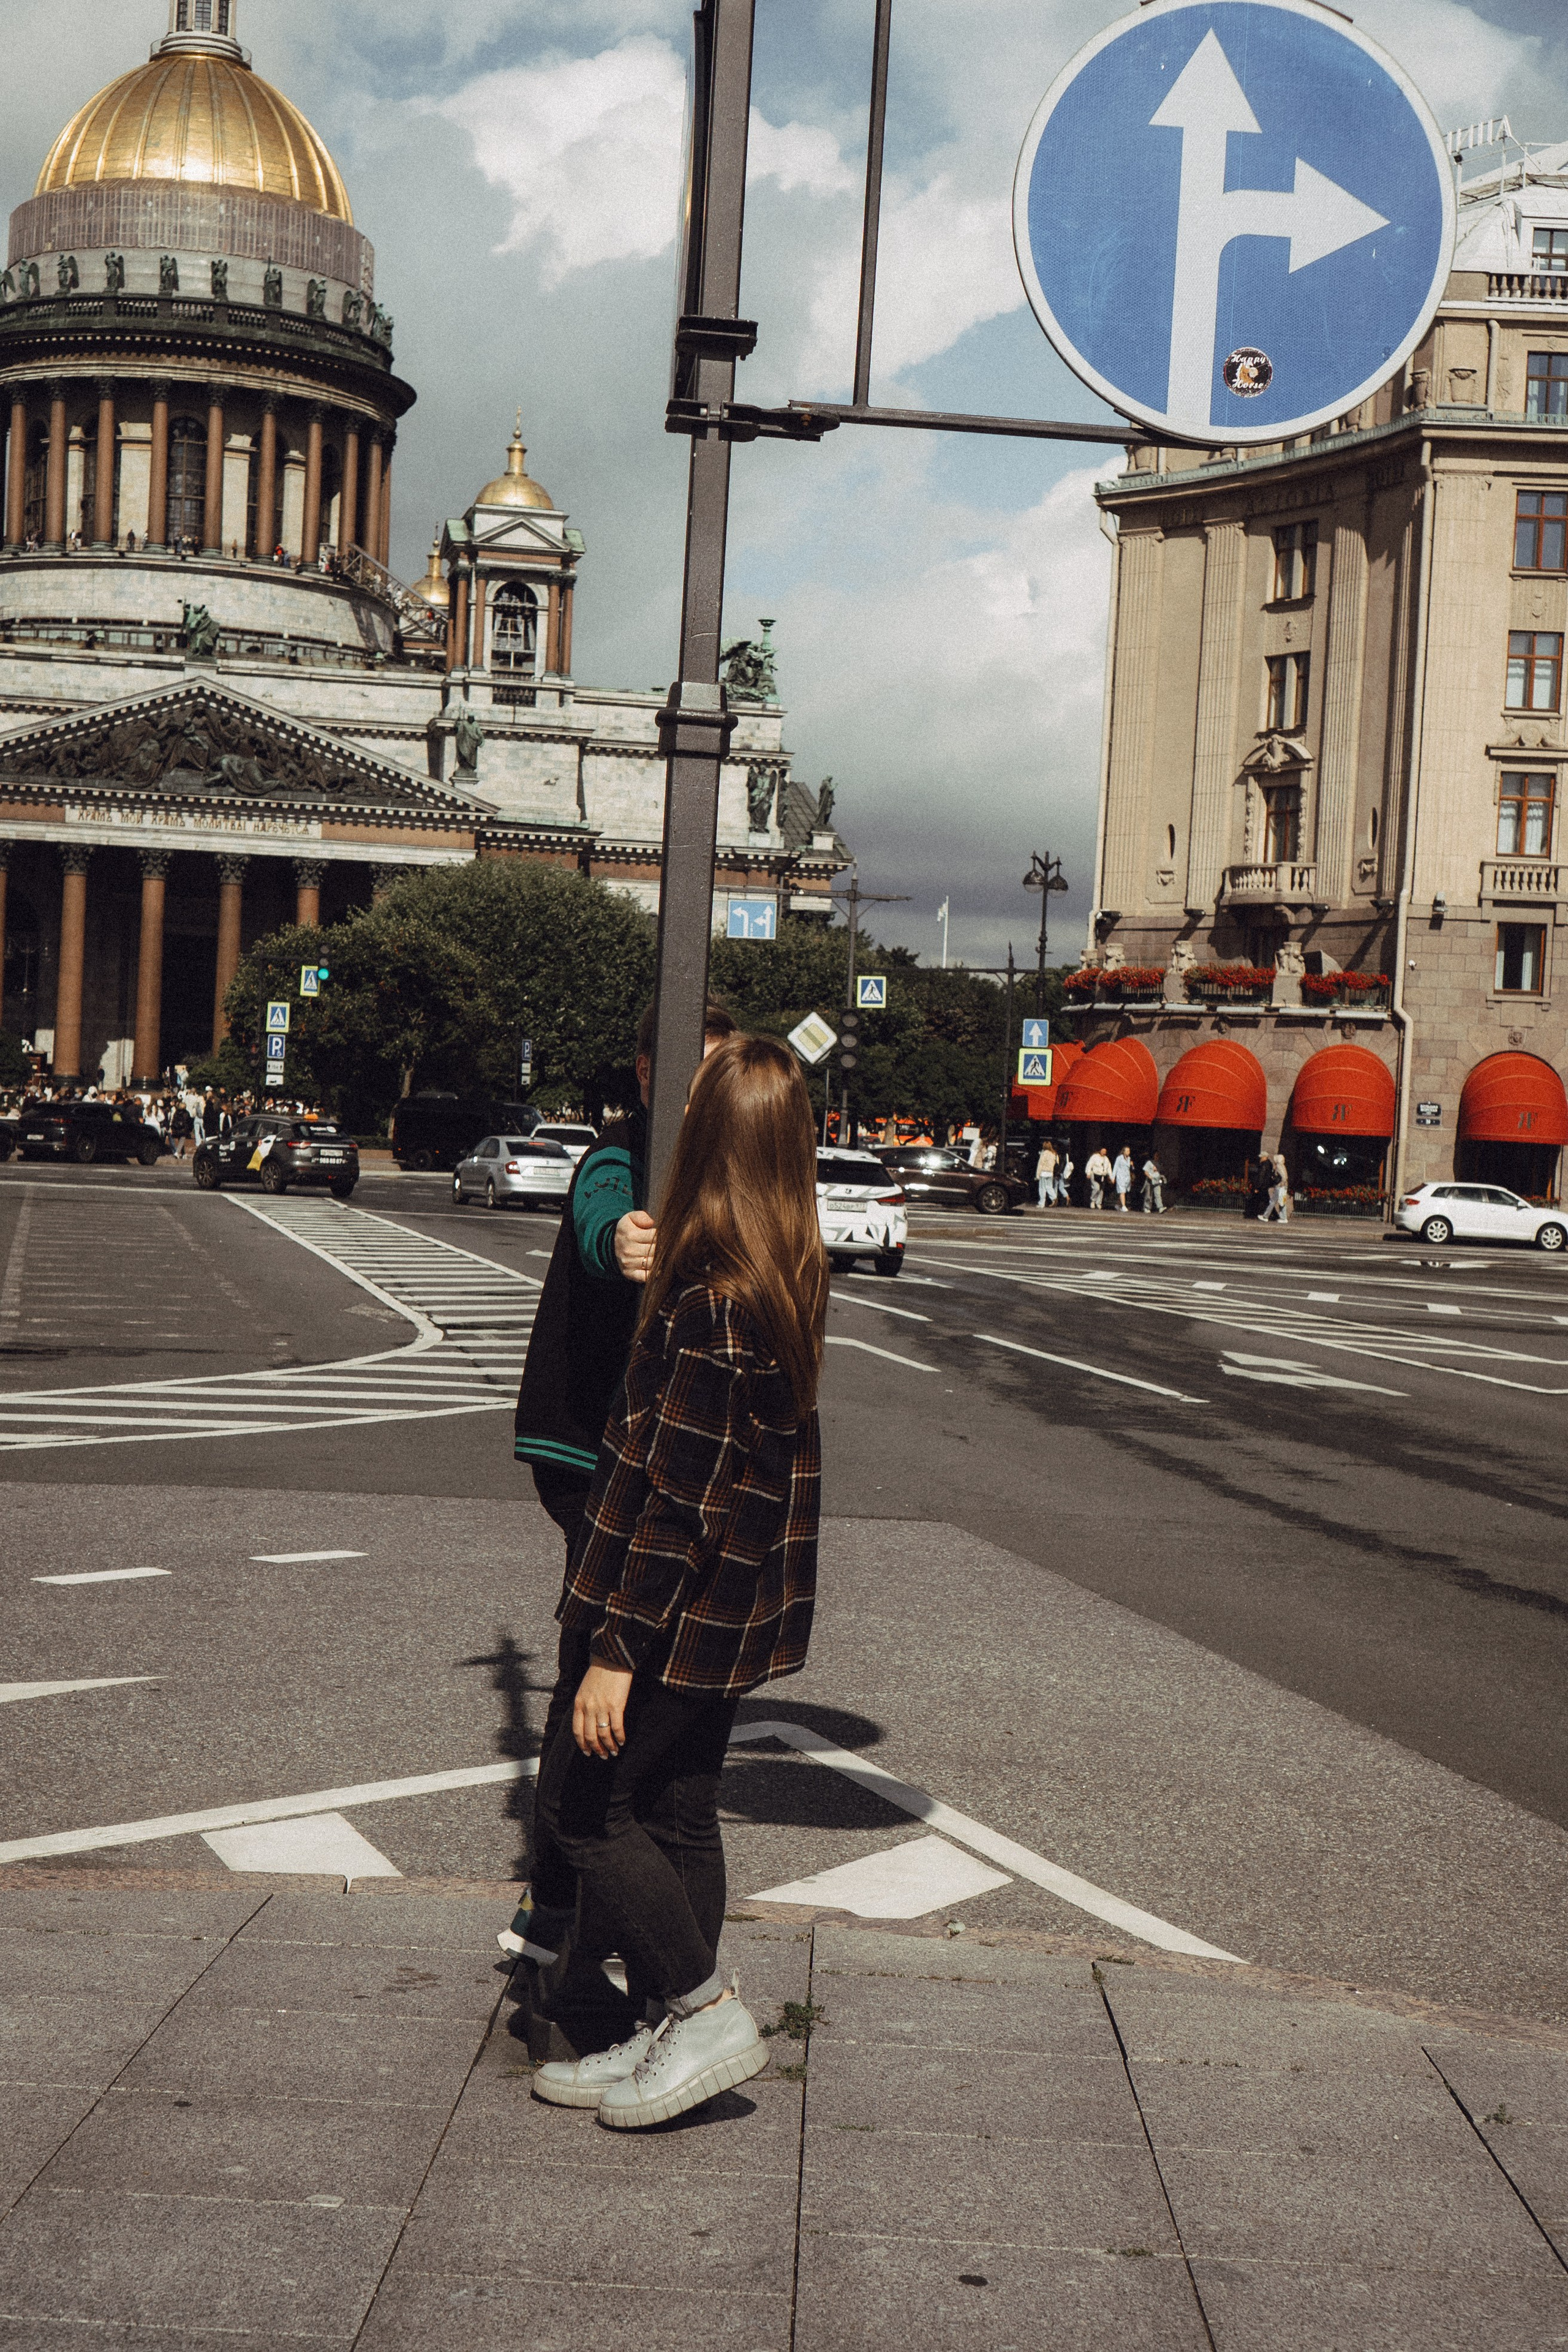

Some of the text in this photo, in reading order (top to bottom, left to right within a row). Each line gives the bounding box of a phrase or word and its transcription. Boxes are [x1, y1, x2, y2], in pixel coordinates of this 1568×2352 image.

[1231, 354, 1267, 364] Happy
[1232, 379, 1264, 389] Horse
[272, 1037, 282, 1055] P
